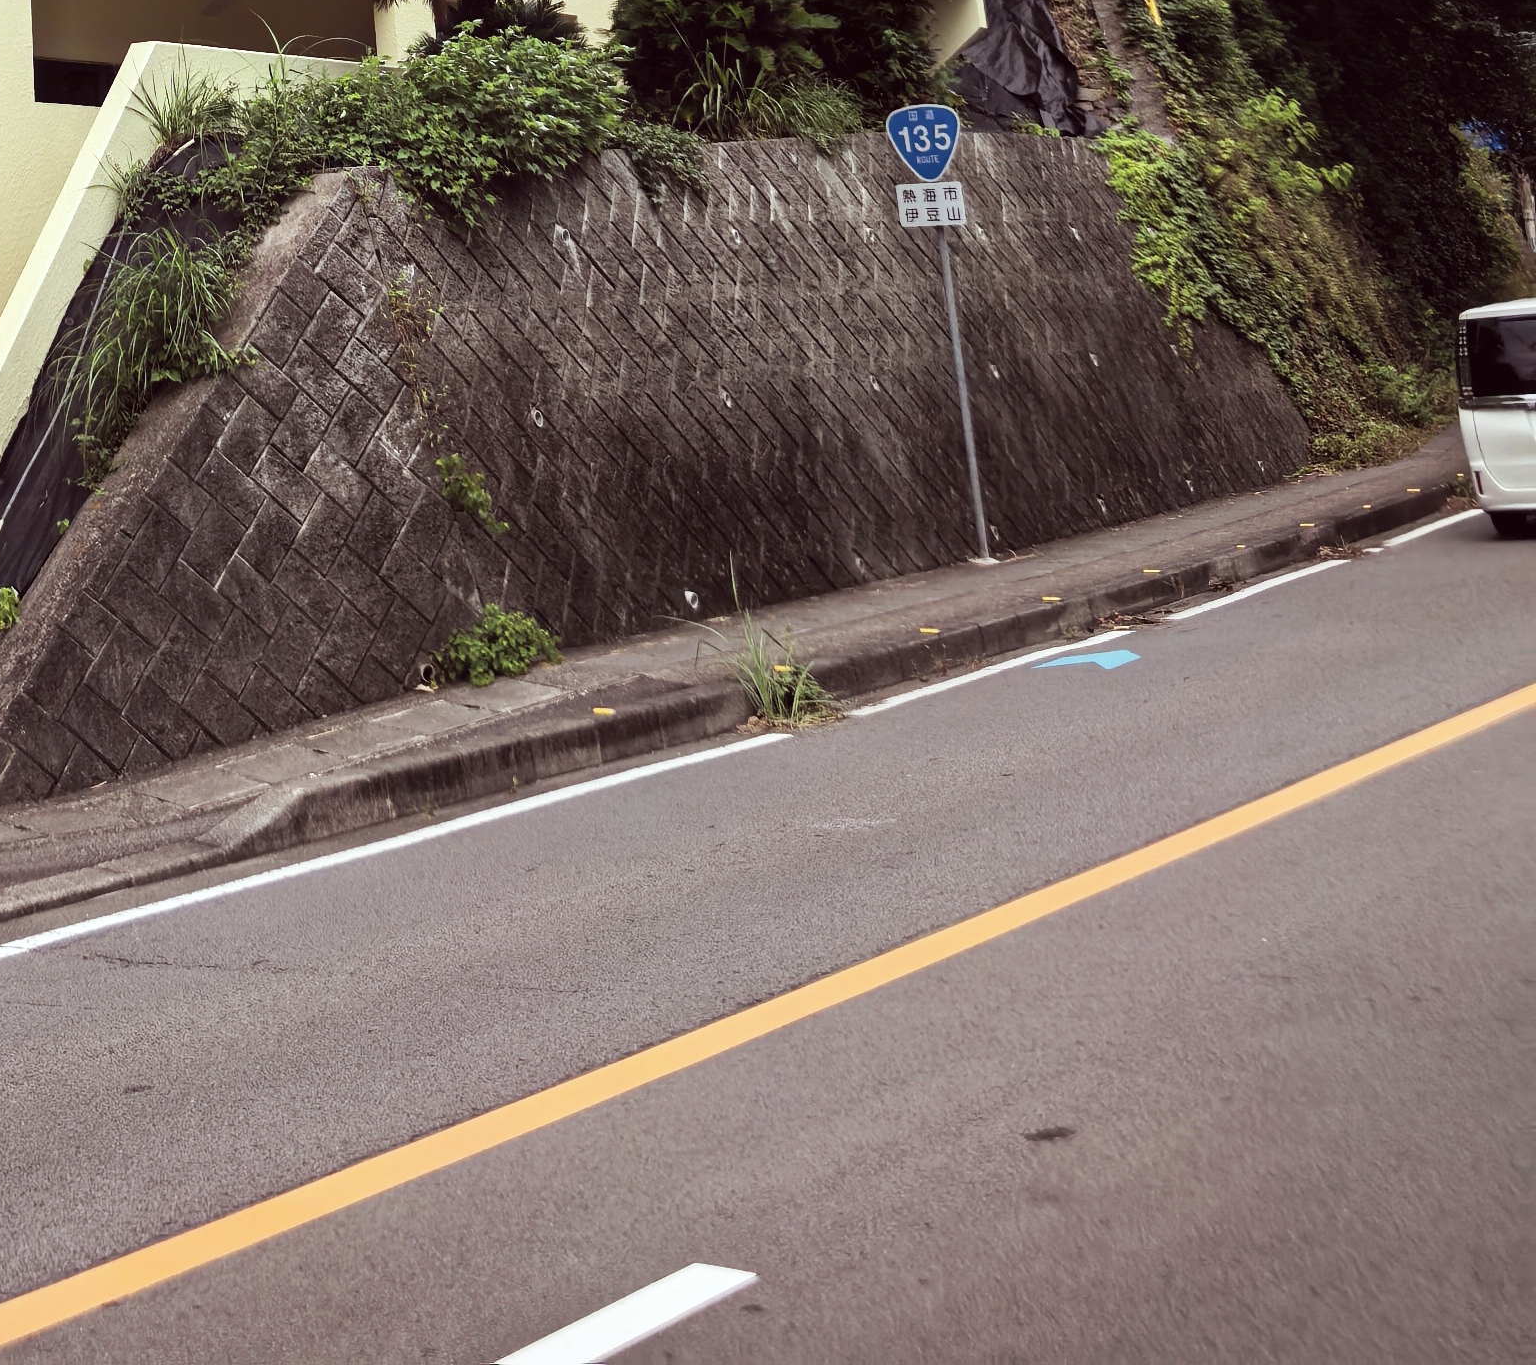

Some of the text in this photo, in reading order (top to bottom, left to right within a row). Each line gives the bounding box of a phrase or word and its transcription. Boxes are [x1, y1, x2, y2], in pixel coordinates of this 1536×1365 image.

[898, 124, 951, 152] 135
[902, 186, 958, 203] 熱海市
[905, 206, 961, 223] 伊豆山
